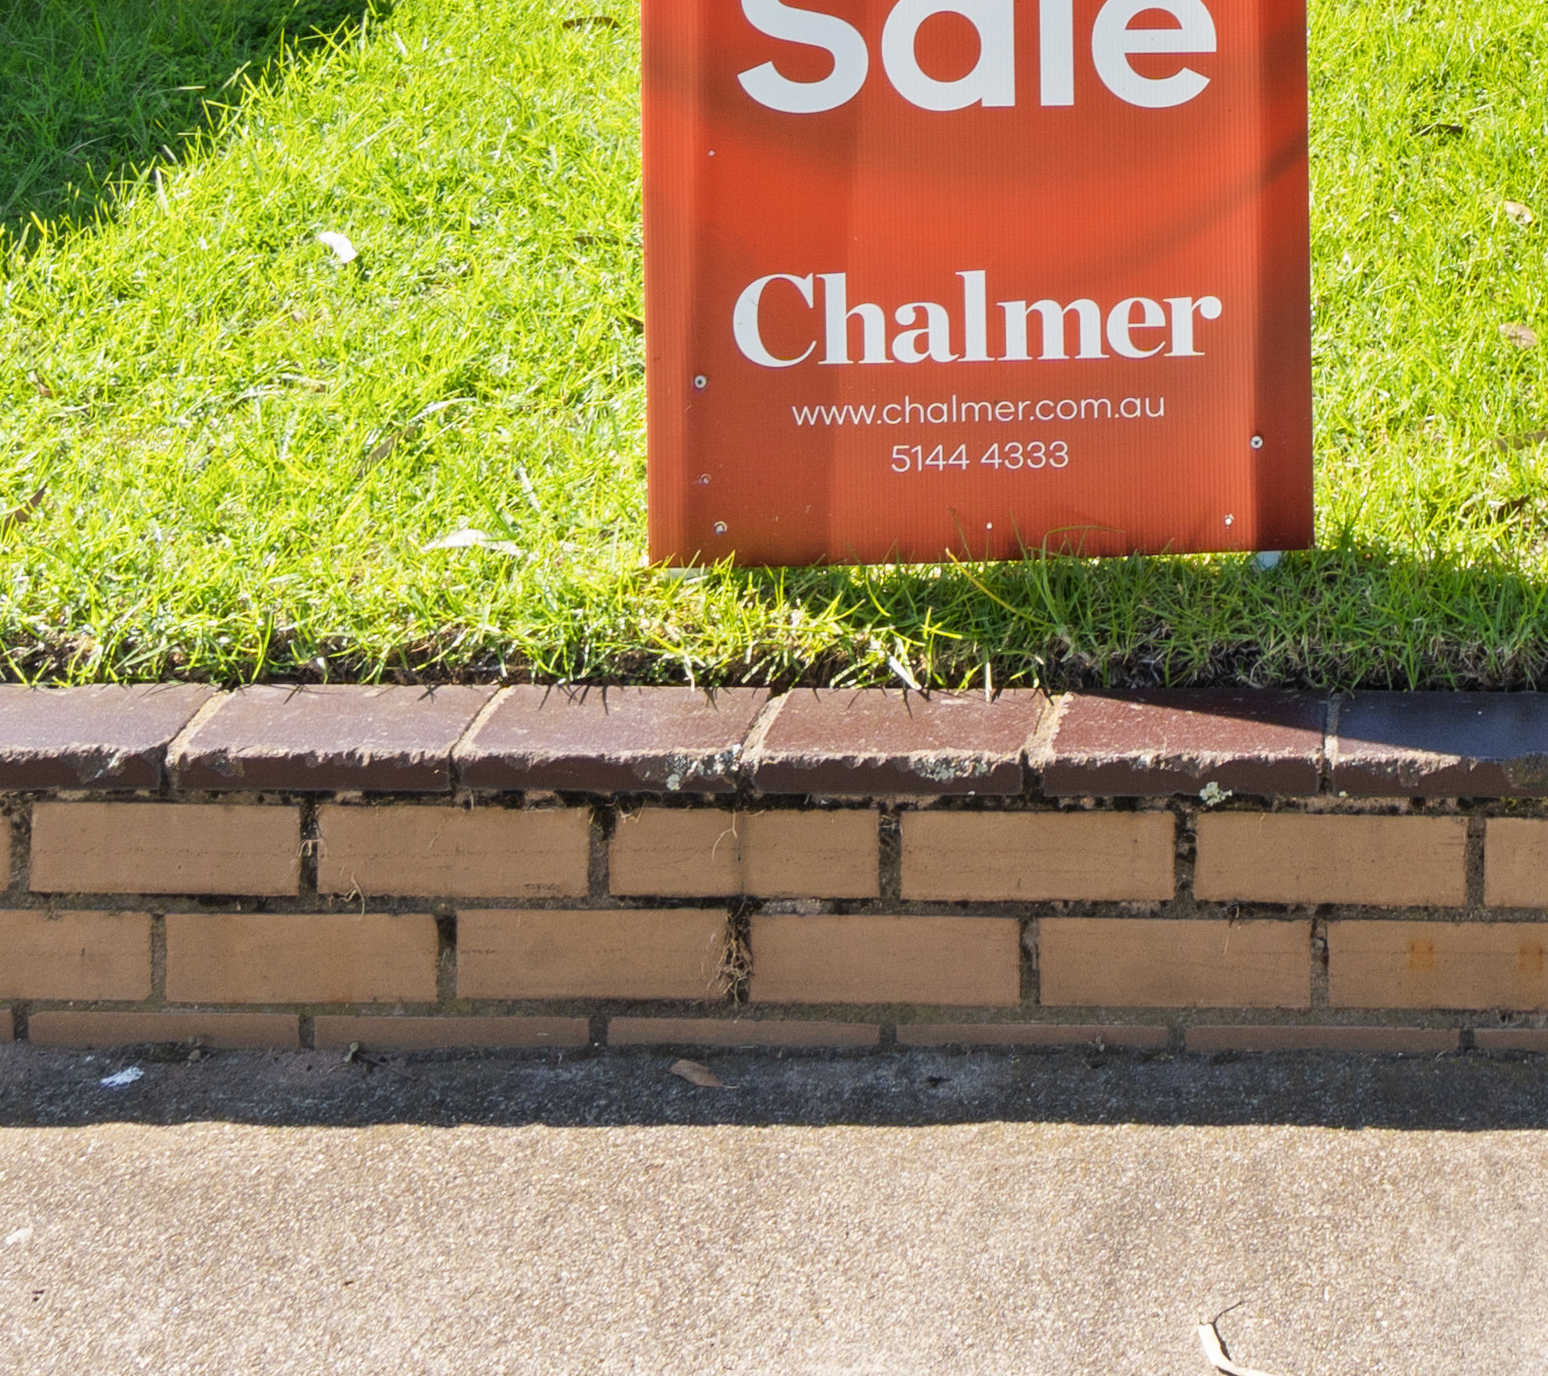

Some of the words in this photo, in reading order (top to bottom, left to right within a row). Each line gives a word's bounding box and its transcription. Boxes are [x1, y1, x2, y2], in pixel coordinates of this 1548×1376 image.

[732, 269, 1223, 368] Chalmer
[791, 394, 1165, 427] www.chalmer.com.au
[890, 443, 971, 473] 5144
[980, 440, 1069, 470] 4333
